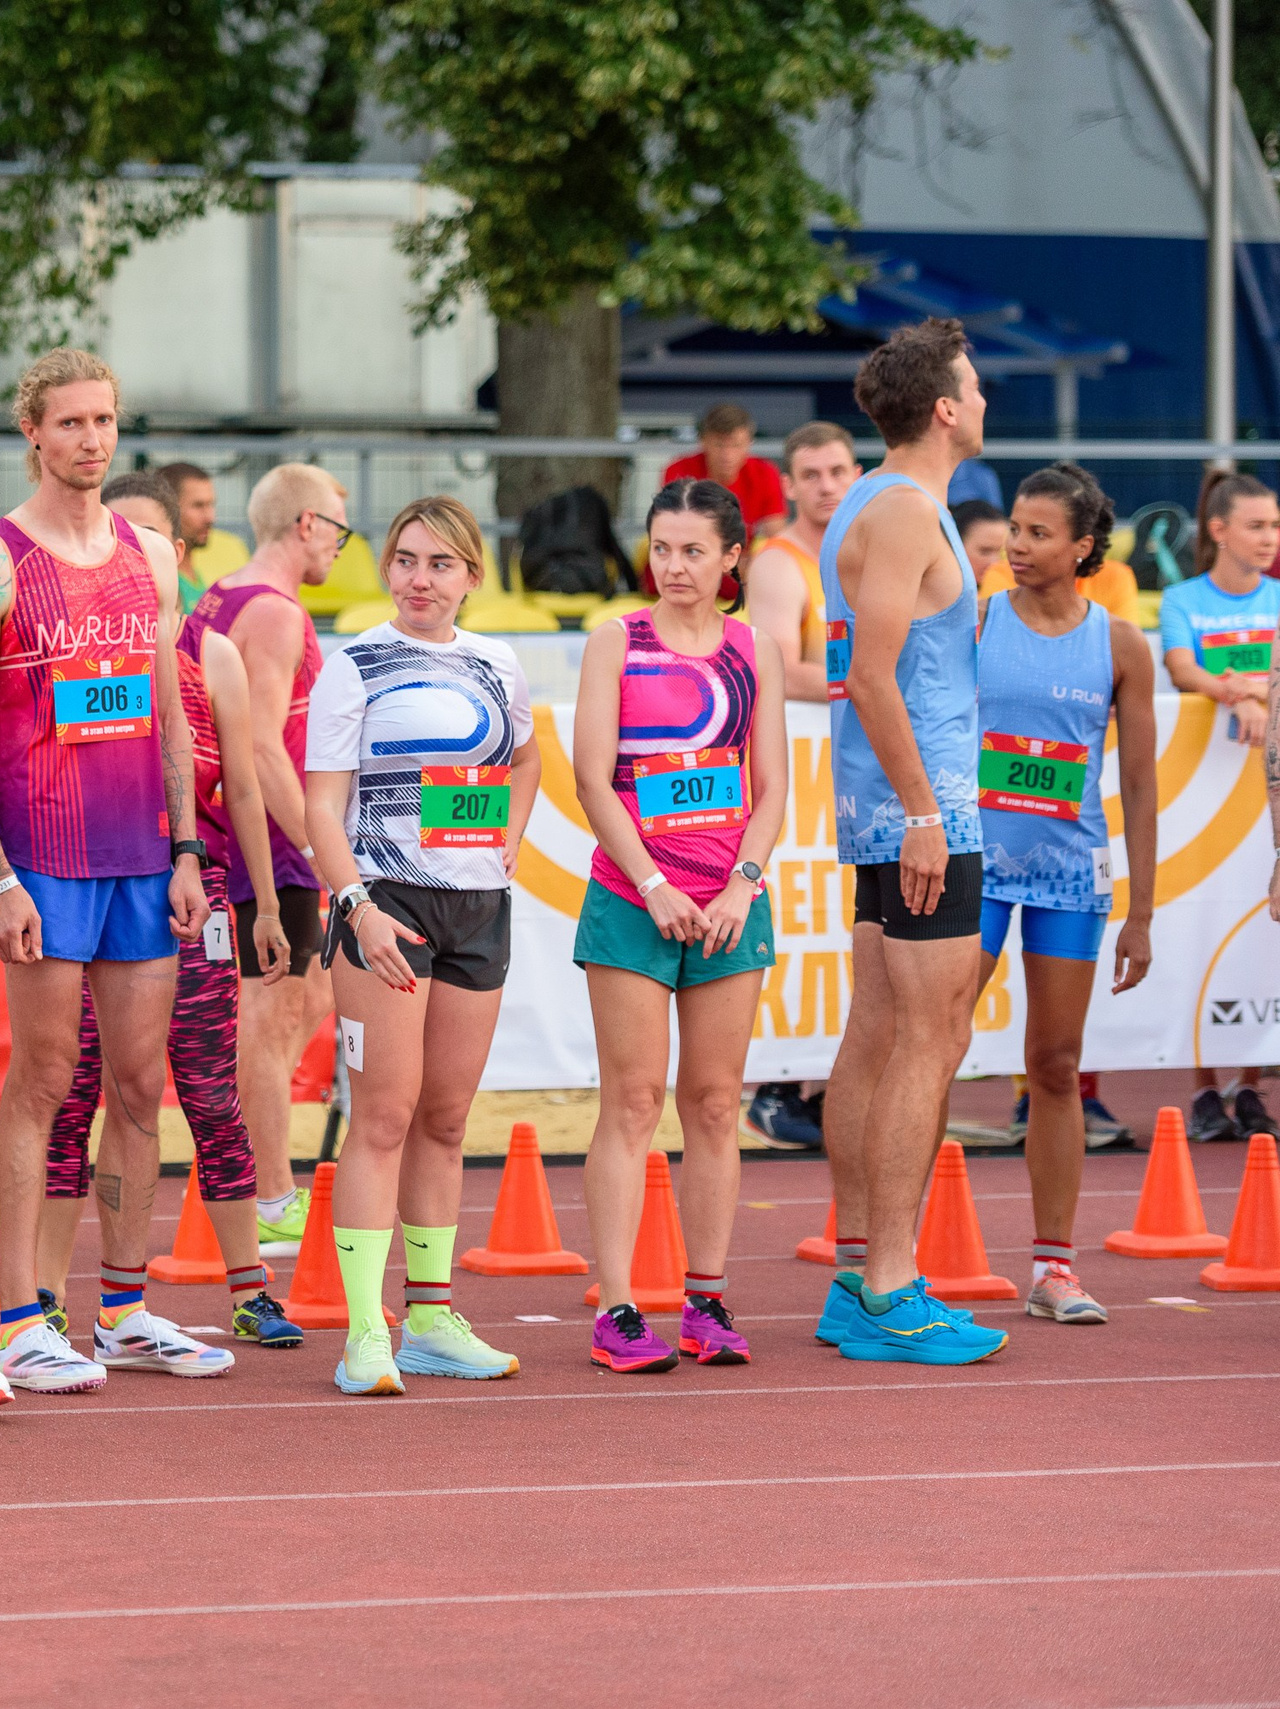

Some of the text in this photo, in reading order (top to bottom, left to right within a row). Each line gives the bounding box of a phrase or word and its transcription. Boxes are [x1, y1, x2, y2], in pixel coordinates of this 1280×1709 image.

[85, 684, 143, 714] 206 3
[1052, 685, 1105, 706] U RUN
[1007, 761, 1073, 795] 209 4
[670, 775, 734, 805] 207 3
[452, 793, 503, 821] 207 4
[1099, 861, 1111, 879] 10
[0, 880, 11, 891] 231
[213, 927, 222, 944] 7
[348, 1035, 355, 1053] 8
